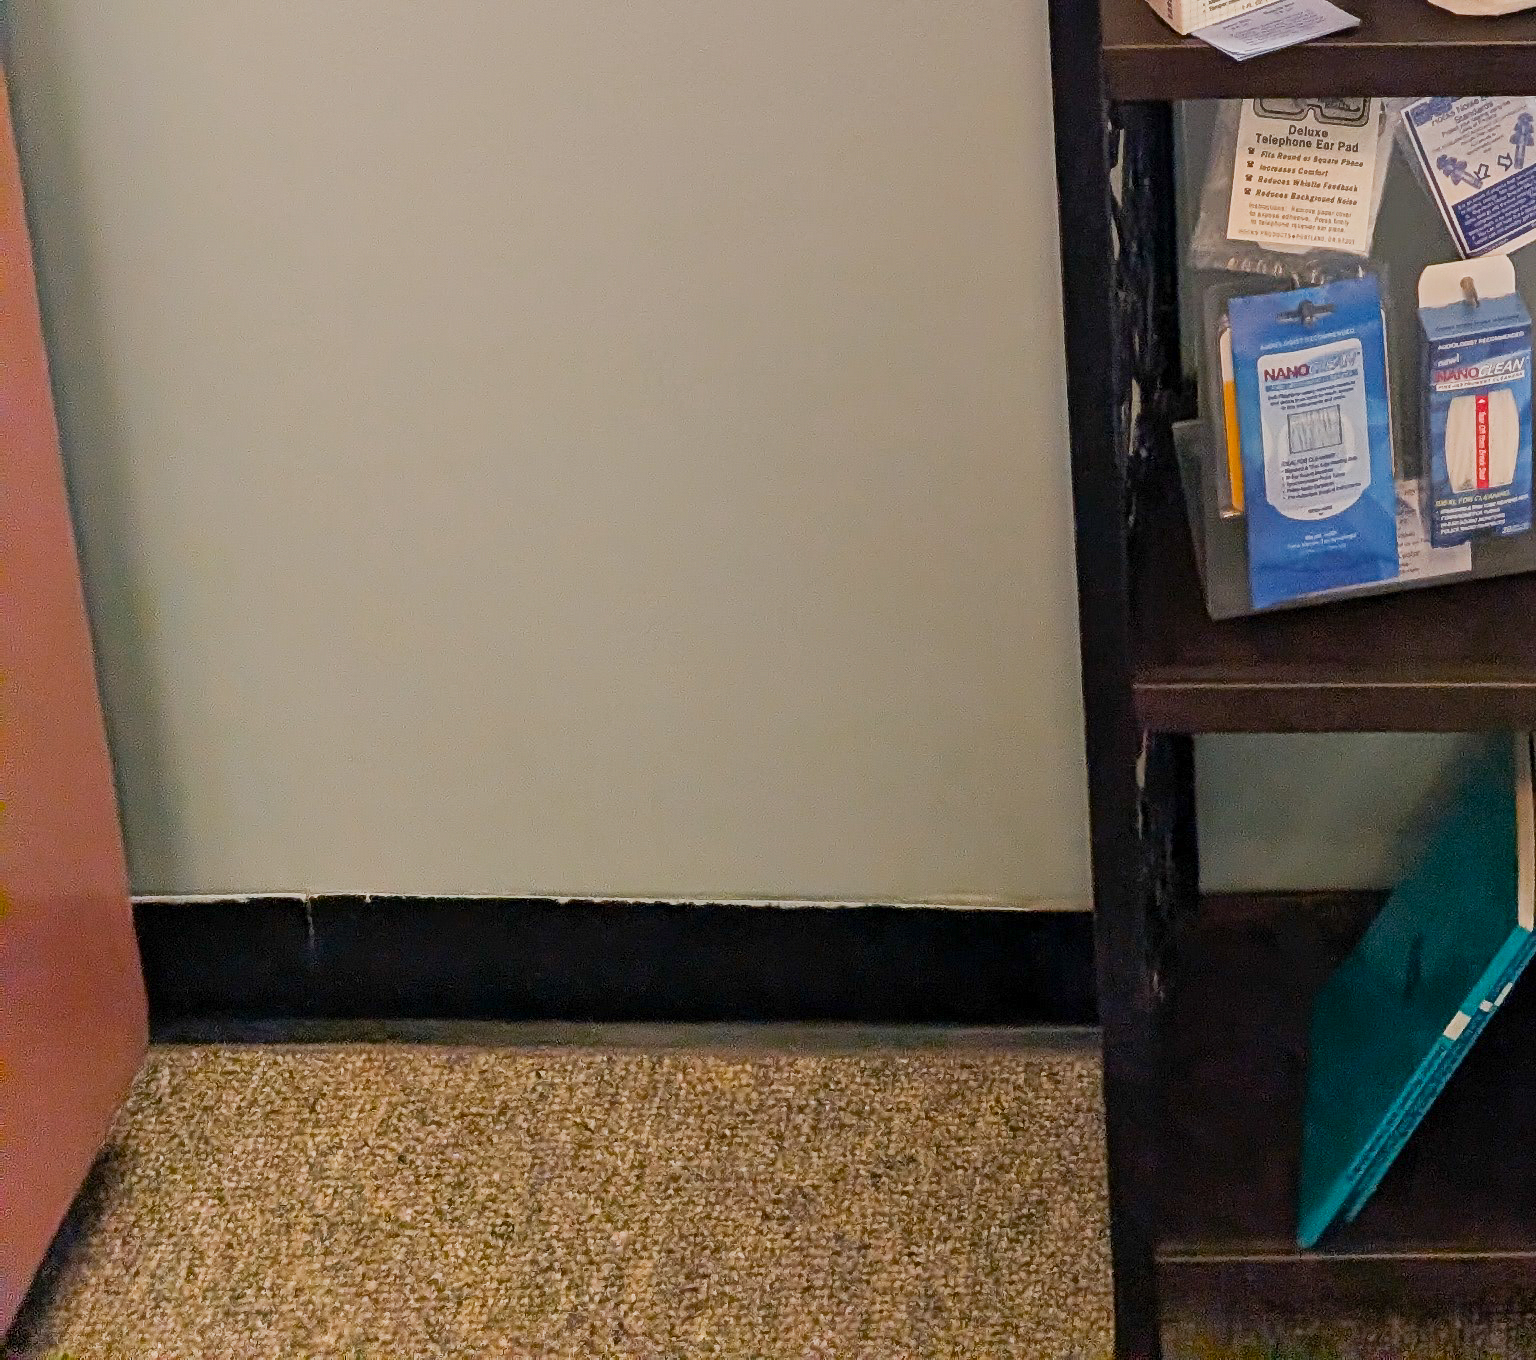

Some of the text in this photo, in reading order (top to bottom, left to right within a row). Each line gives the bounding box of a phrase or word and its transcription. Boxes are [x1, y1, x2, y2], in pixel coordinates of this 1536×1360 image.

[1288, 124, 1329, 138] Deluxe
[1255, 132, 1359, 153] Telephone Ear Pad
[1260, 150, 1276, 159] Fits
[1276, 152, 1301, 162] Round
[1312, 156, 1339, 166] Square
[1259, 164, 1329, 177] Increases Comfort
[1257, 175, 1358, 192] Reduces Whistle Feedback
[1255, 188, 1358, 206] Reduces Background Noise
